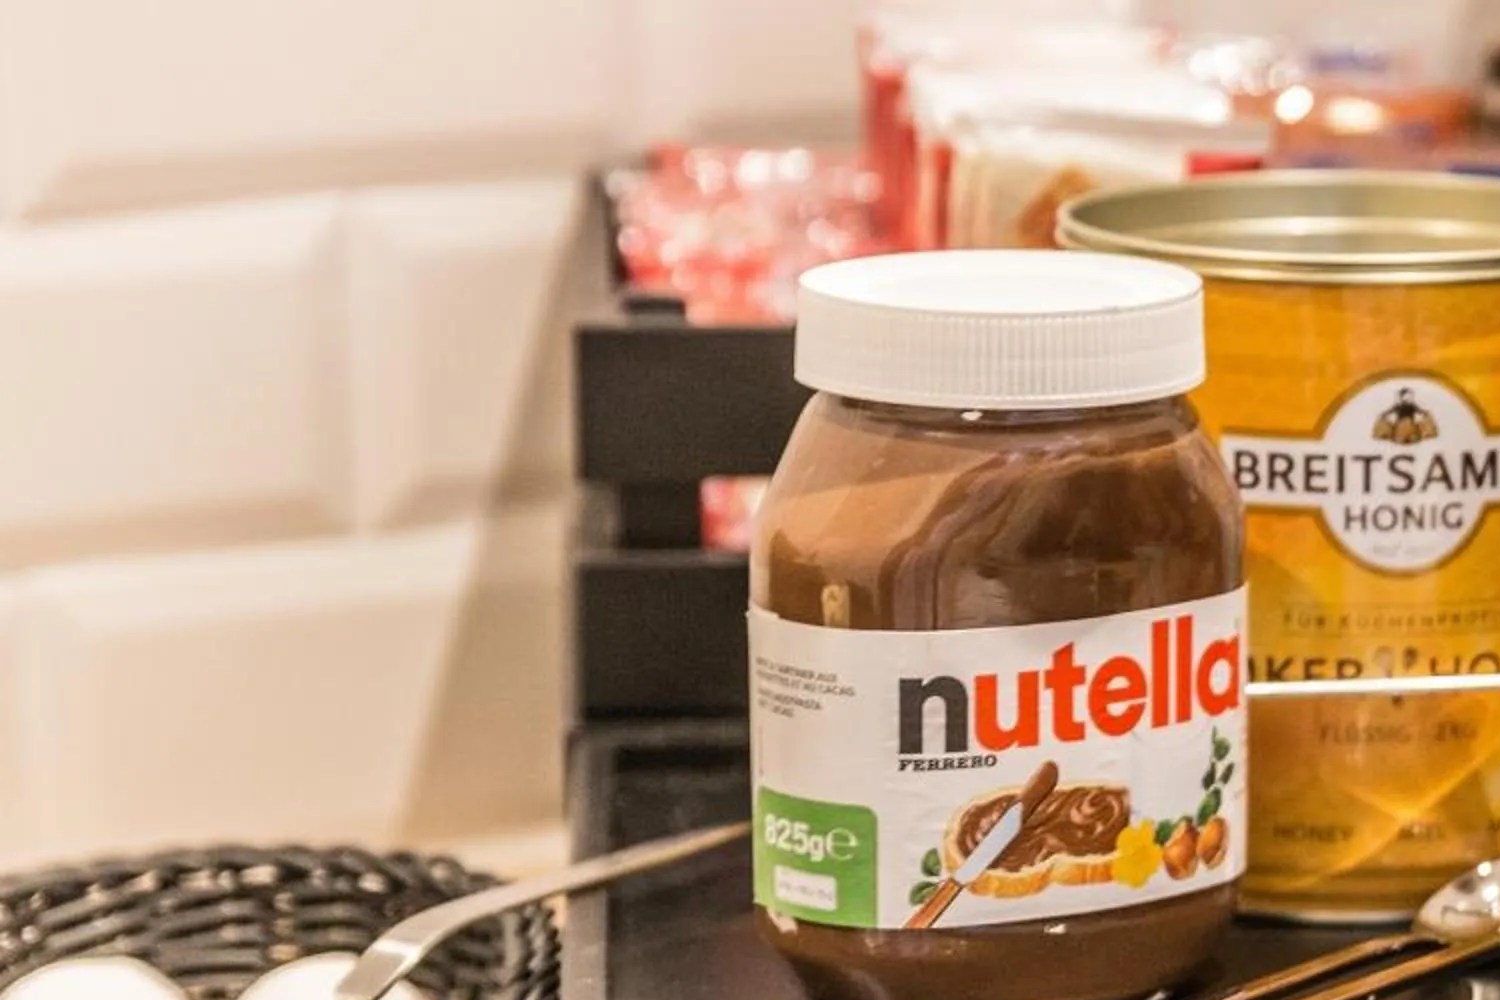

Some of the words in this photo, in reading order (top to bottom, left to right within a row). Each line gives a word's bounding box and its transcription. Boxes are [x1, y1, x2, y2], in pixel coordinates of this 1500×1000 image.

[1343, 502, 1465, 532] HONIG
[898, 614, 1240, 754] nutella
[897, 754, 998, 773] FERRERO
